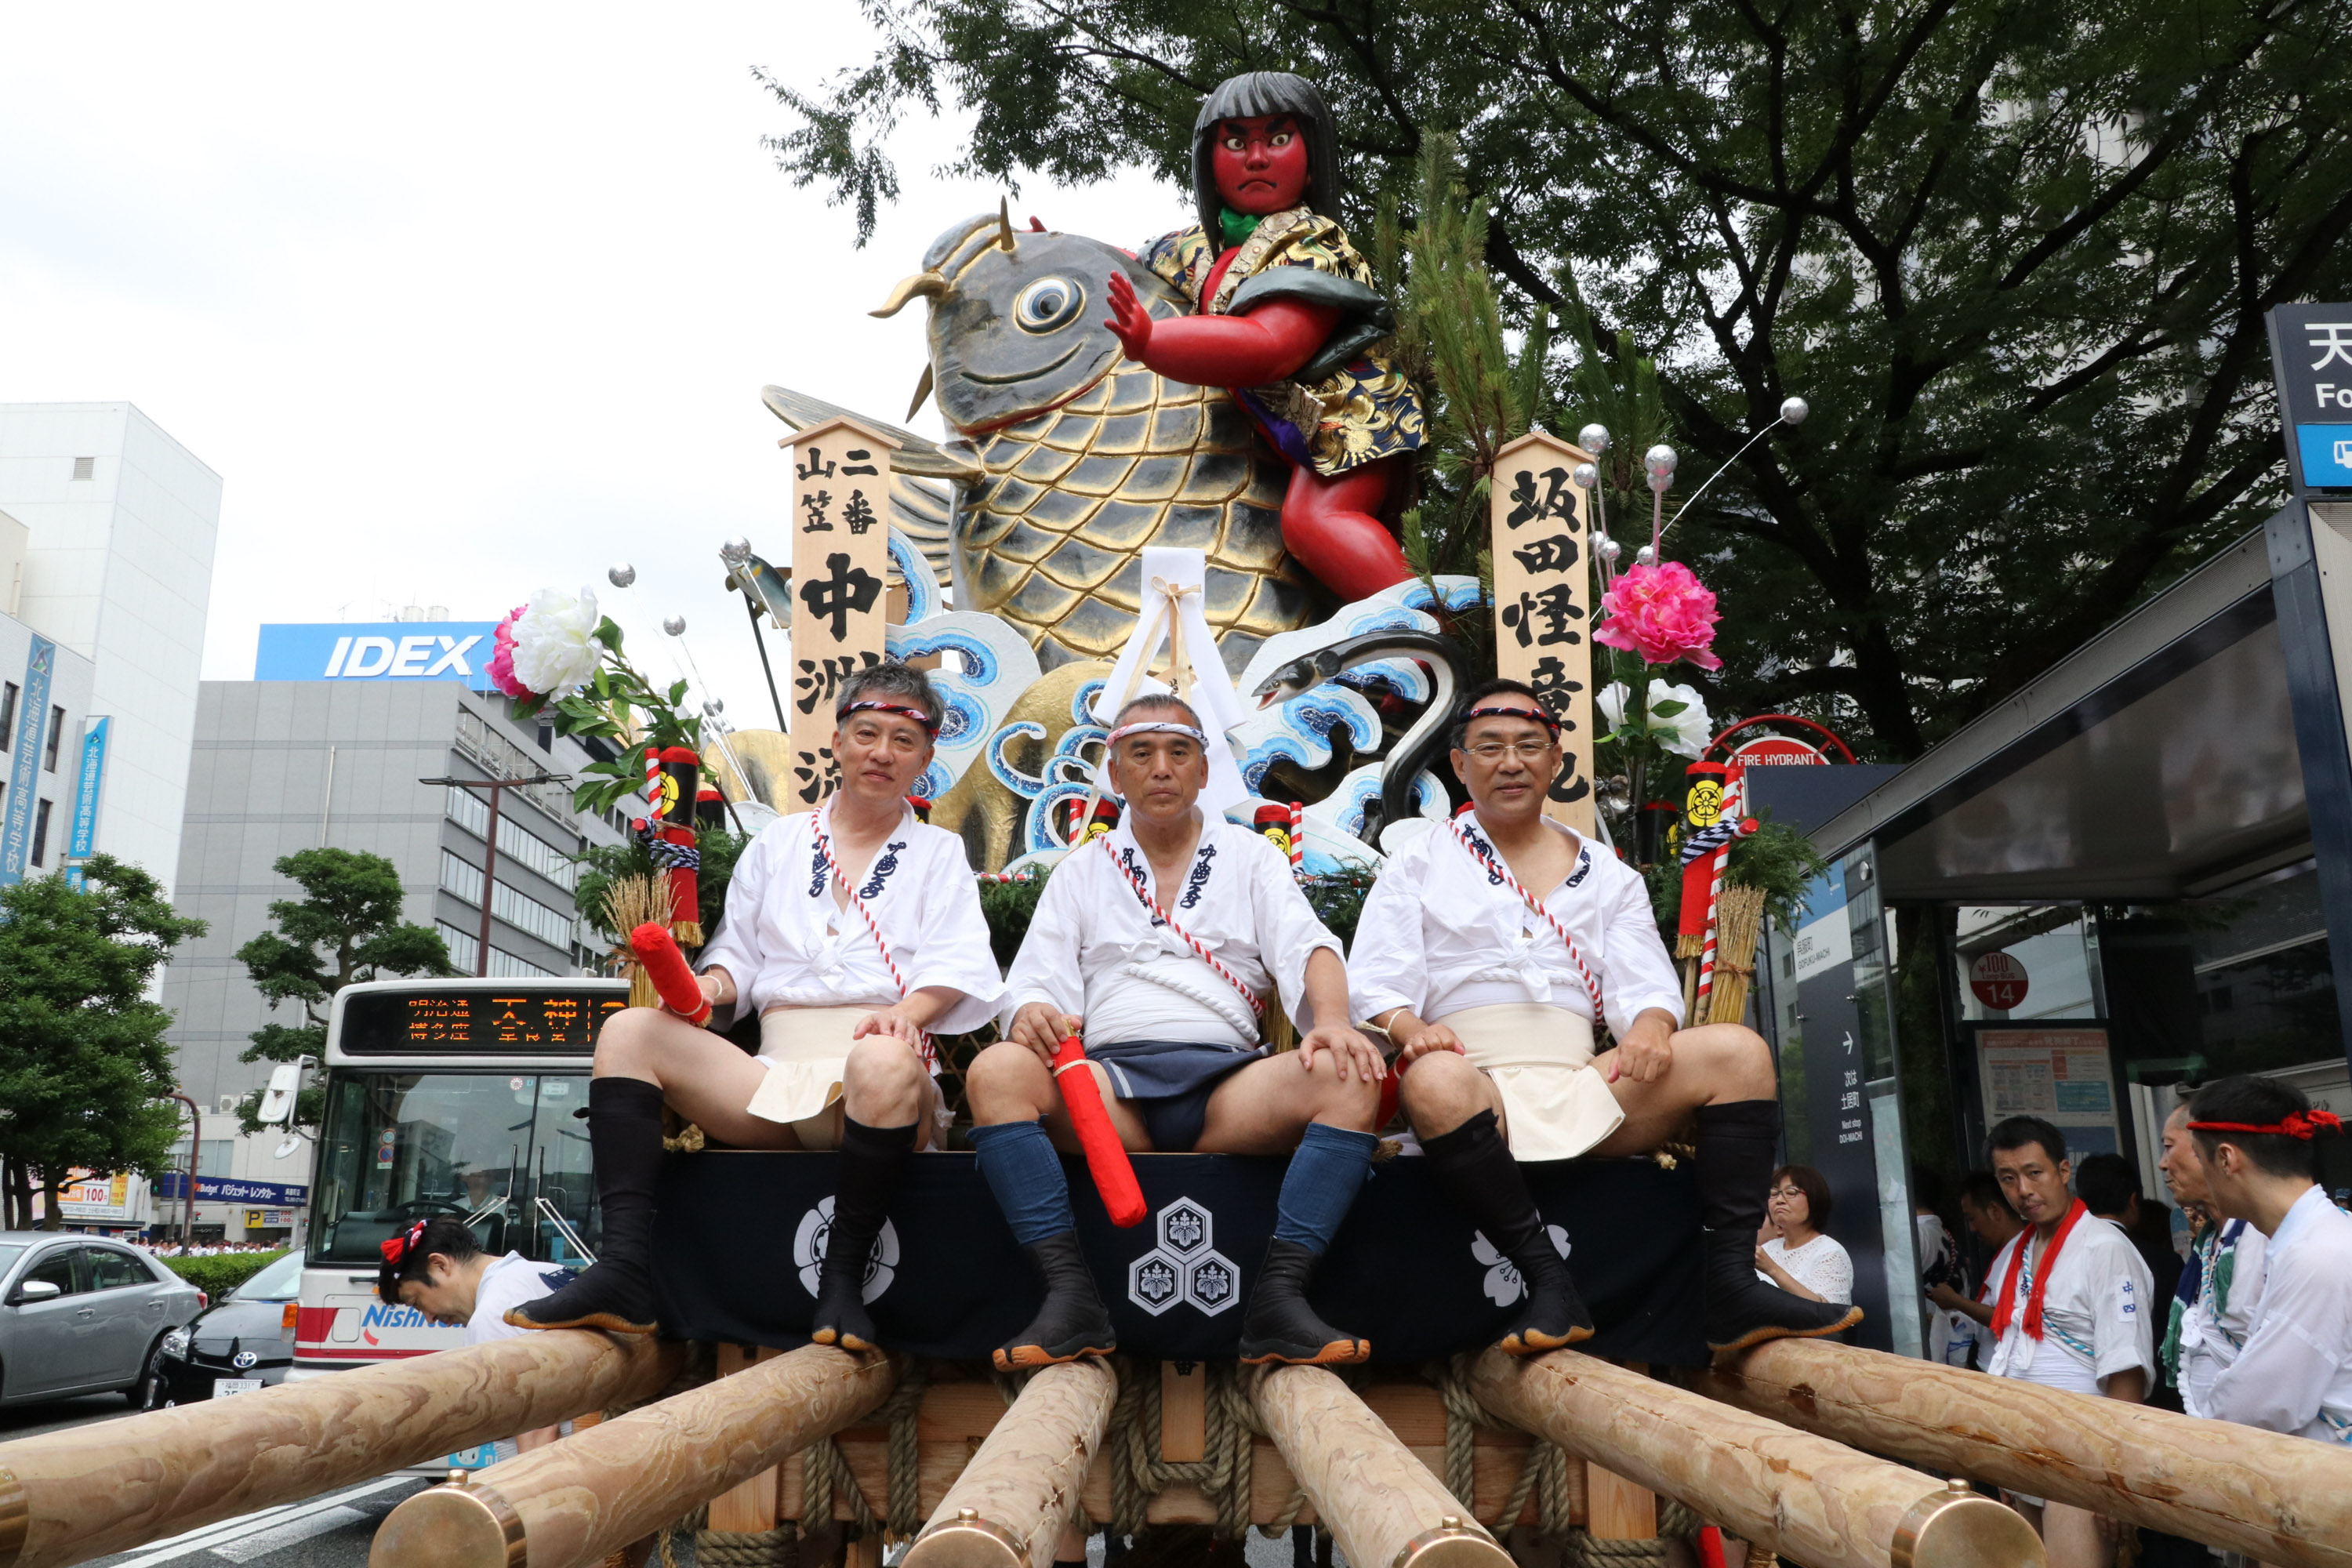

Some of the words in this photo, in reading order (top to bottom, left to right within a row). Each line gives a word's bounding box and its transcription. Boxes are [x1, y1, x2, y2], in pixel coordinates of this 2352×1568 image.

[795, 447, 837, 534] 山笠
[840, 448, 879, 535] 二番
[324, 635, 484, 677] IDEX
[1737, 754, 1762, 766] FIRE
[1765, 753, 1816, 765] HYDRANT
[1987, 984, 2015, 1003] 14
[1844, 1069, 1858, 1087] 次は
[1841, 1091, 1860, 1110] 土居町
[1842, 1120, 1852, 1130] Next
[1852, 1118, 1862, 1128] stop
[1839, 1131, 1863, 1144] DOI-MACHI
[250, 1187, 276, 1199] レンタカー
[248, 1211, 260, 1225] P
